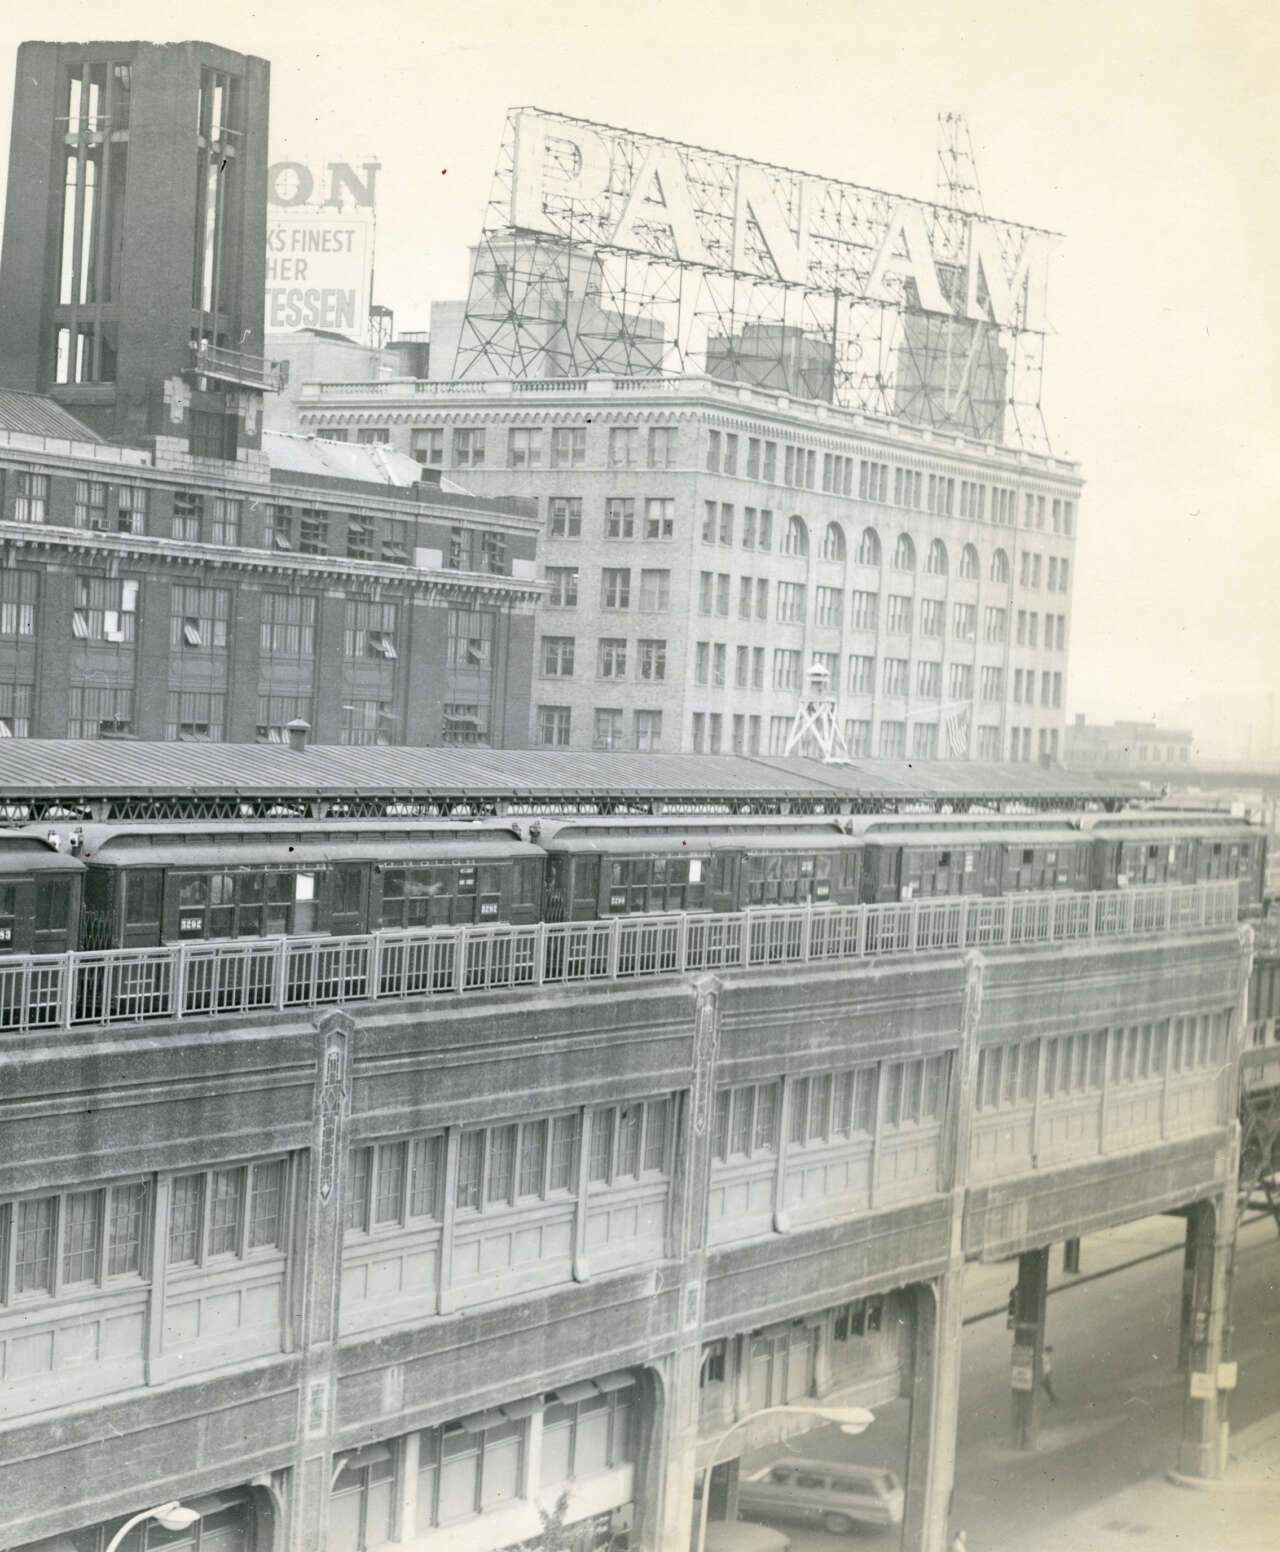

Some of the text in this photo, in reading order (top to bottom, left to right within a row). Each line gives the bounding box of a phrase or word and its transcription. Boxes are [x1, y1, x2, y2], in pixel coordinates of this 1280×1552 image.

[268, 161, 382, 207] ON
[291, 229, 356, 253] FINEST
[512, 111, 1067, 335] PAN AM
